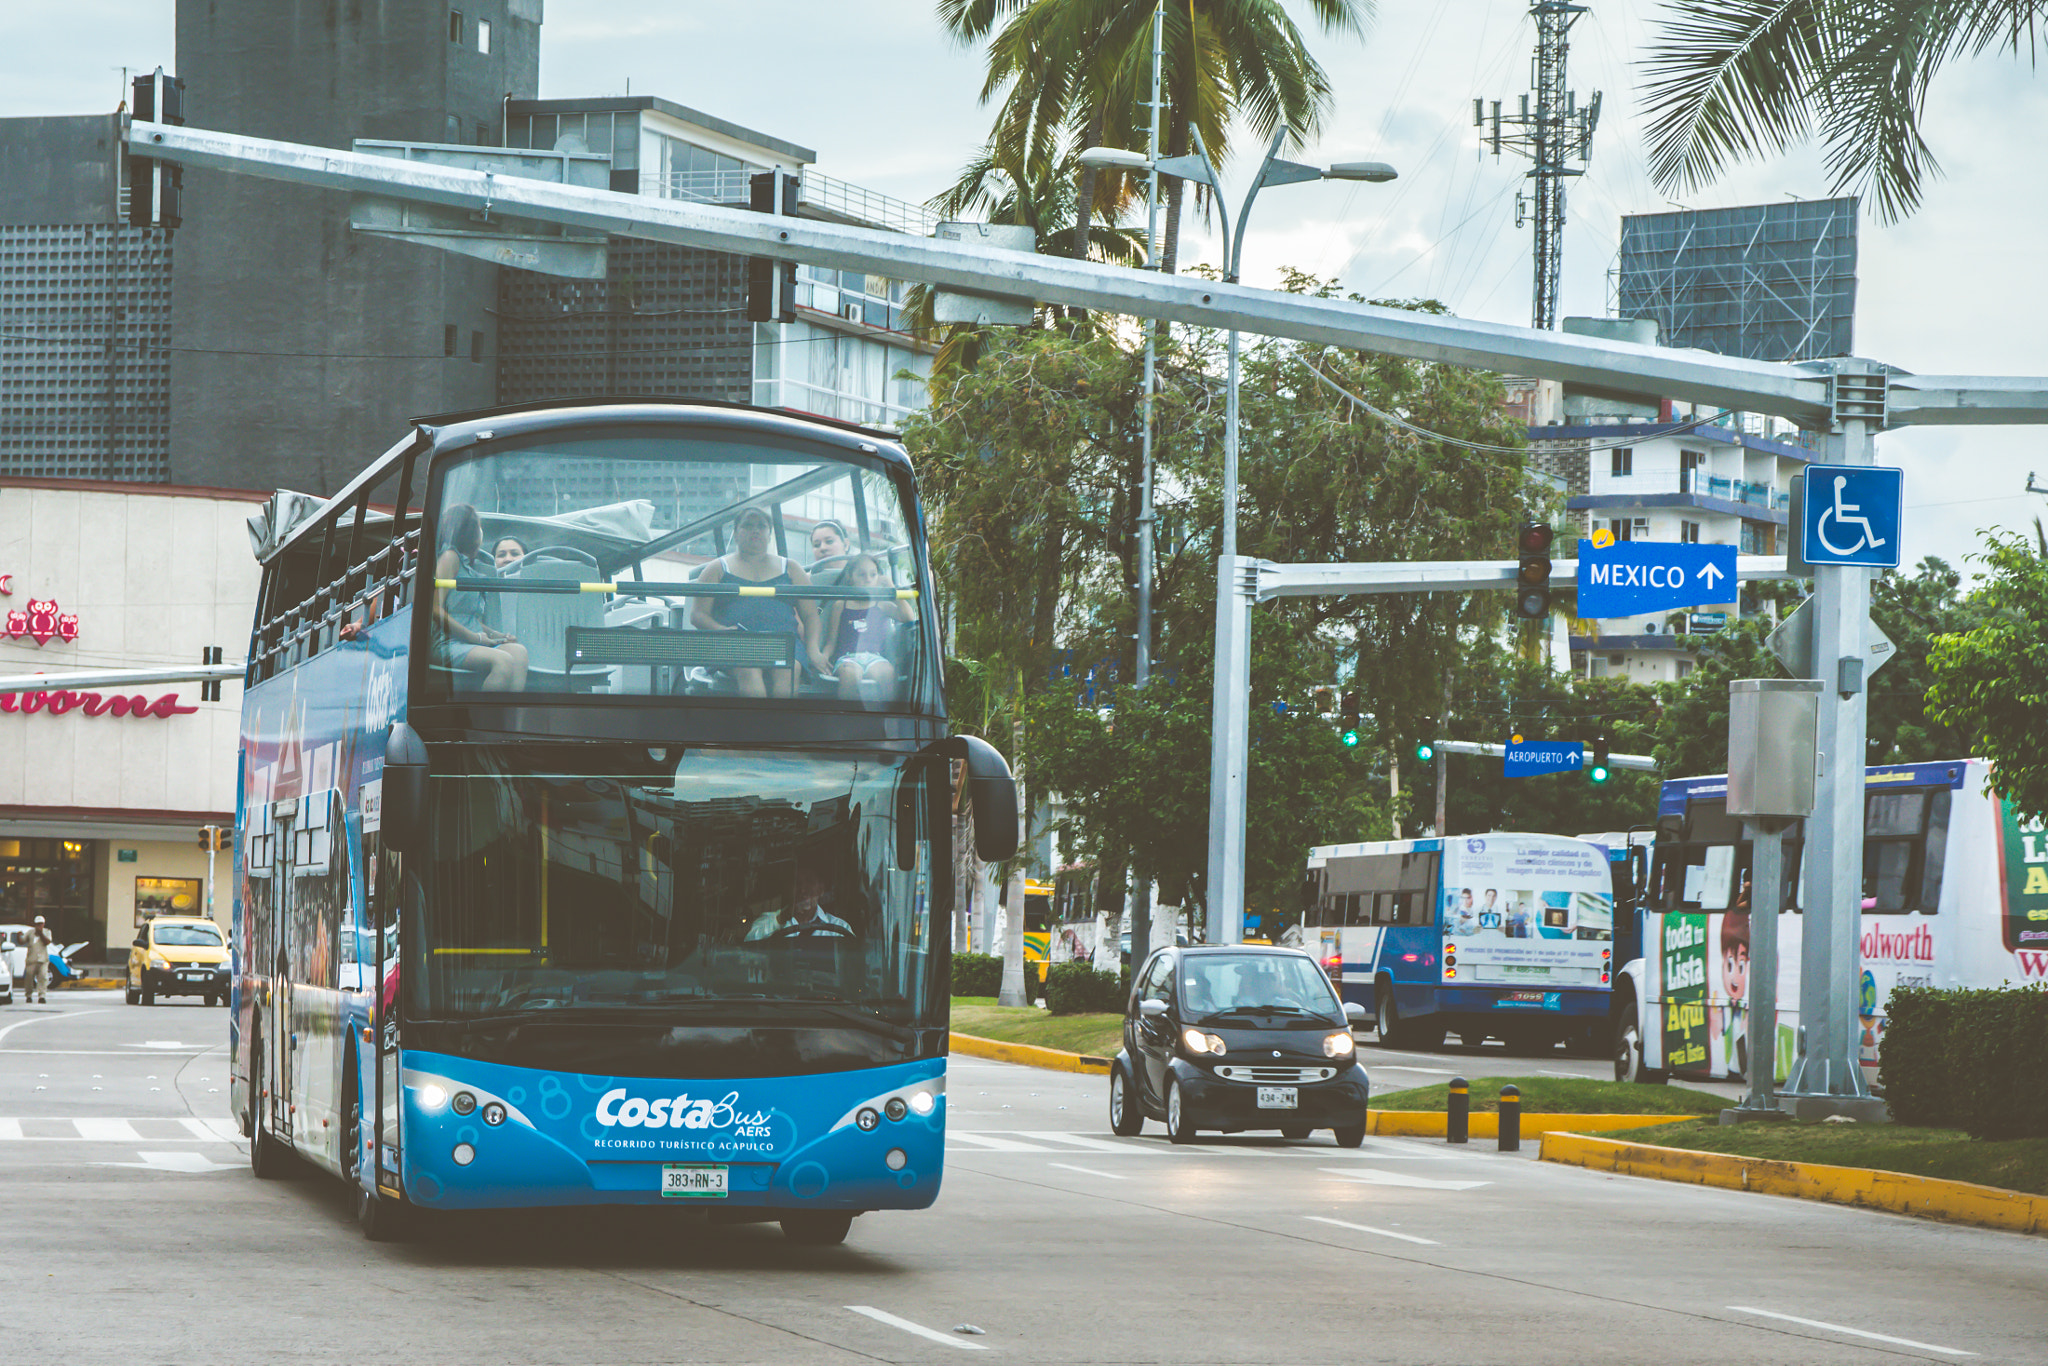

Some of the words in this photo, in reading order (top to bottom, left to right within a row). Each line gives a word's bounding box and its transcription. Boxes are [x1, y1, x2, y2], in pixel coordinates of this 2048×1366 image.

[1590, 563, 1685, 588] MEXICO
[1508, 751, 1563, 763] AEROPUERTO
[1665, 917, 1693, 952] toda
[1860, 922, 1934, 960] olworth
[1666, 952, 1705, 992] Lista
[1667, 990, 1705, 1040] Aquí
[1686, 1042, 1706, 1063] lista
[735, 1126, 771, 1137] AERS
[594, 1139, 655, 1149] RECORRIDO
[660, 1139, 715, 1150] TURÍSTICO
[718, 1142, 774, 1151] ACAPULCO
